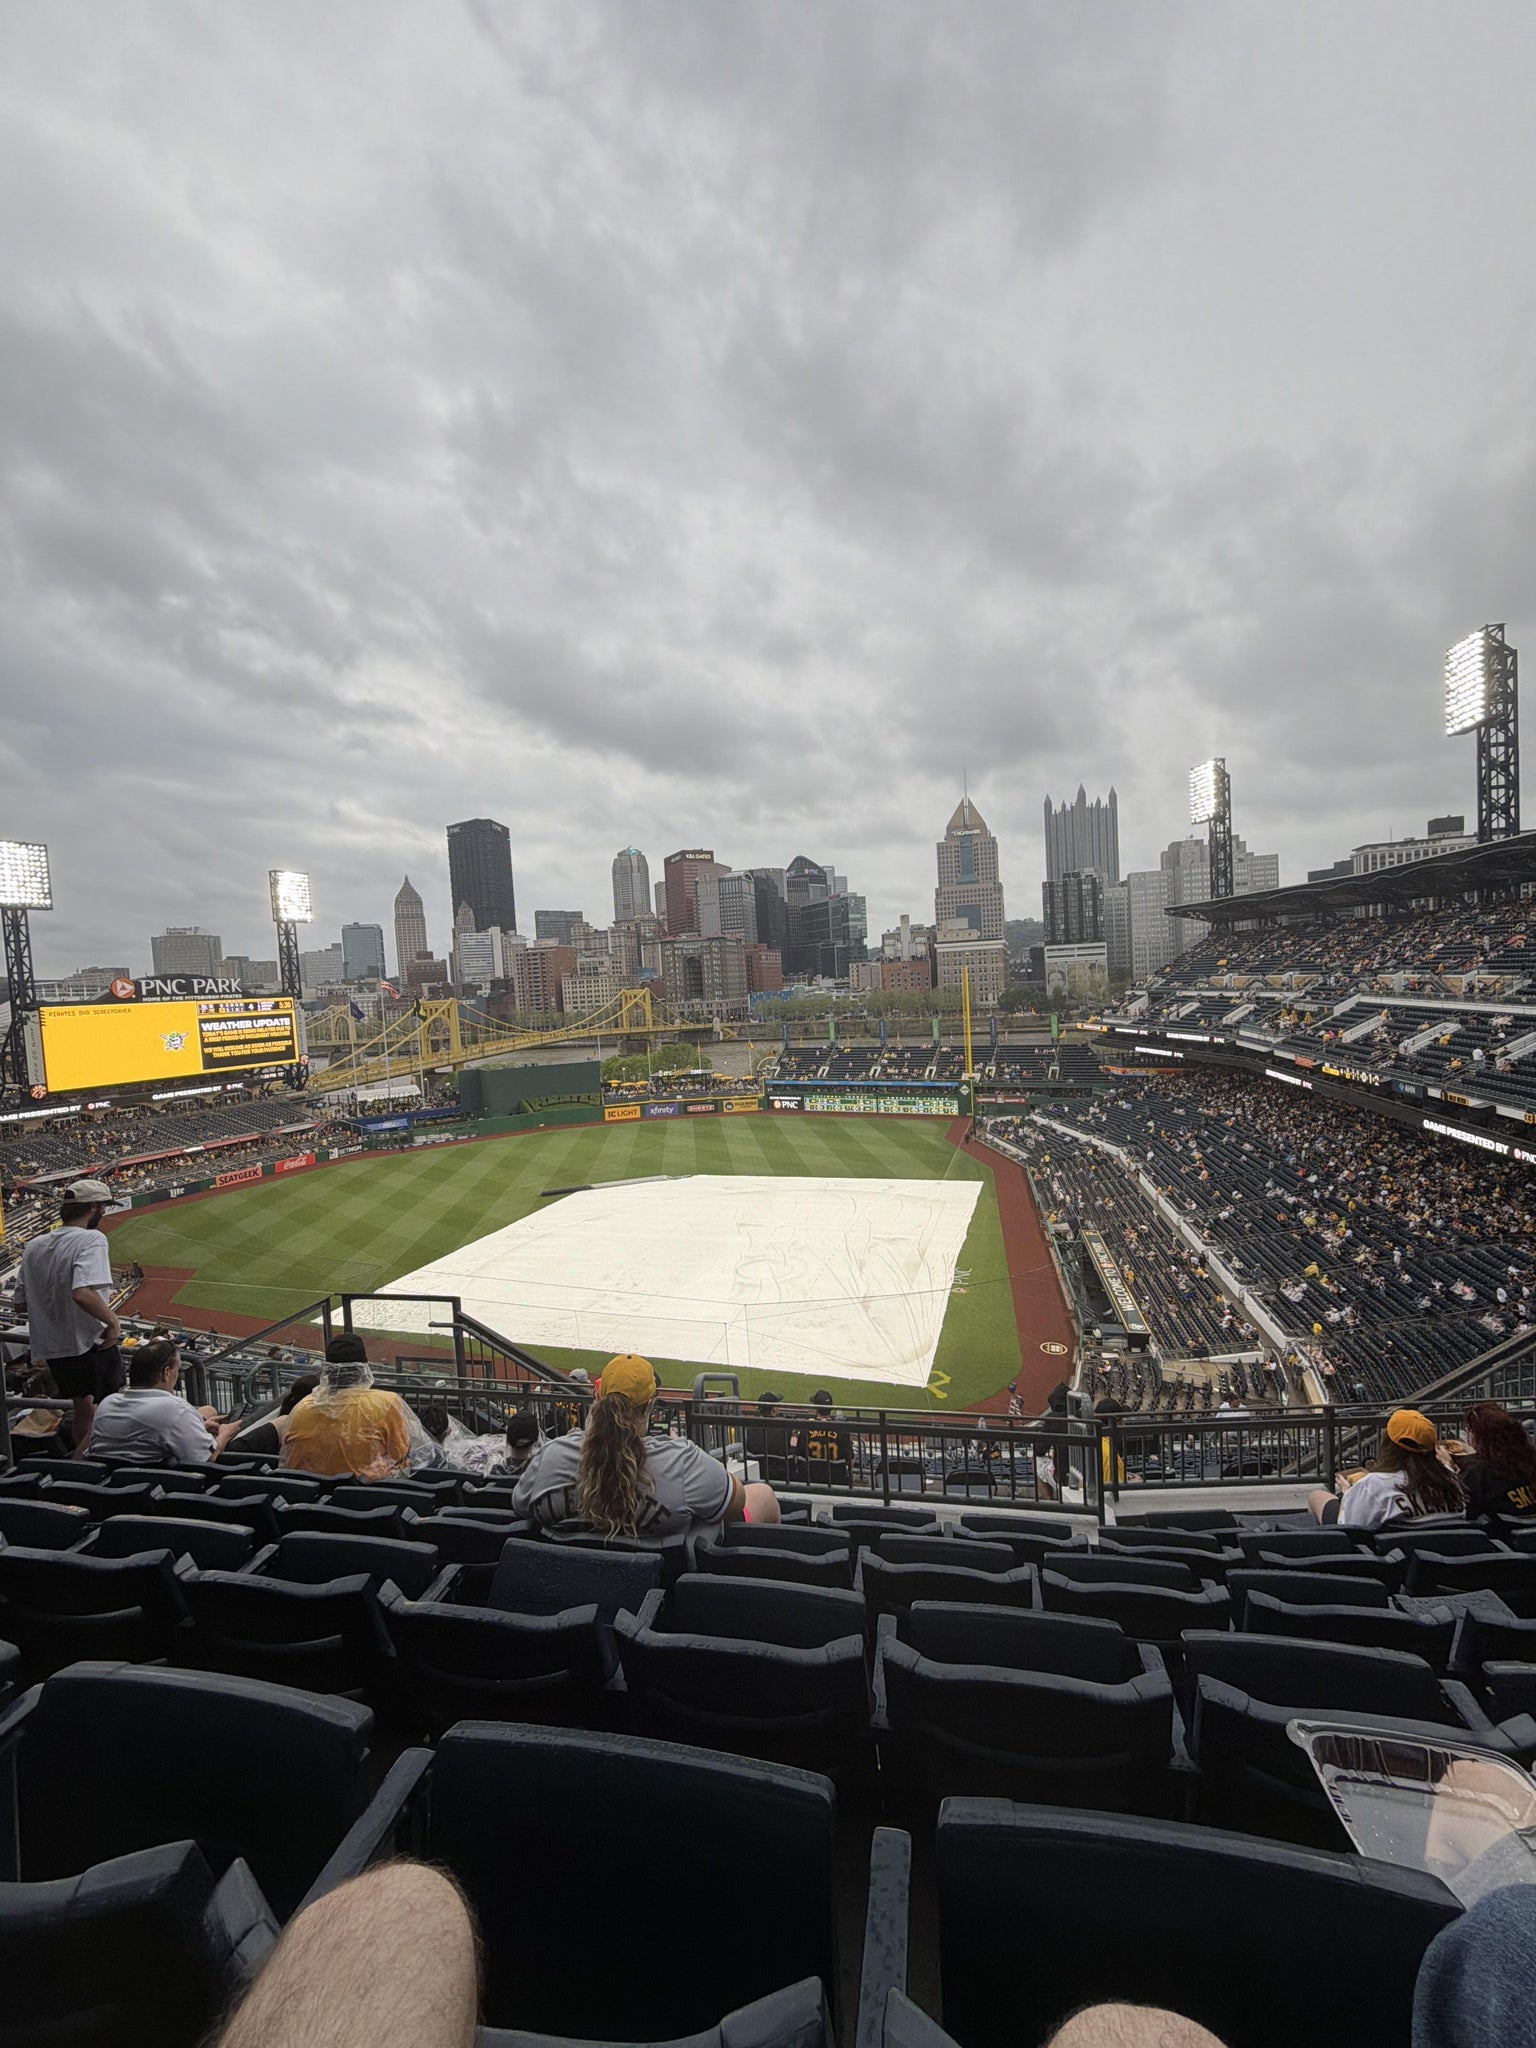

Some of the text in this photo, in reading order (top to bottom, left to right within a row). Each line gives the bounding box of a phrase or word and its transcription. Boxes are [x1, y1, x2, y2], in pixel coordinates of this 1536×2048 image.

[140, 977, 243, 995] PNC PARK
[93, 1008, 132, 1016] SCREENSAVER
[201, 1017, 291, 1031] WEATHER UPDATE
[152, 1091, 174, 1100] GAME
[174, 1087, 212, 1097] PRESENTED
[212, 1085, 222, 1093] BY
[649, 1104, 674, 1116] xfinity
[781, 1100, 799, 1109] PNC
[18, 1106, 69, 1119] PRESENTED
[607, 1109, 638, 1119] IC LIGHT
[1423, 1119, 1536, 1164] GAME PRESENTED BY PNC
[283, 1156, 307, 1170] Coca-Cola
[218, 1168, 260, 1186] SEATGEEK
[1103, 1268, 1118, 1277] TO
[1107, 1277, 1136, 1311] WELCOME
